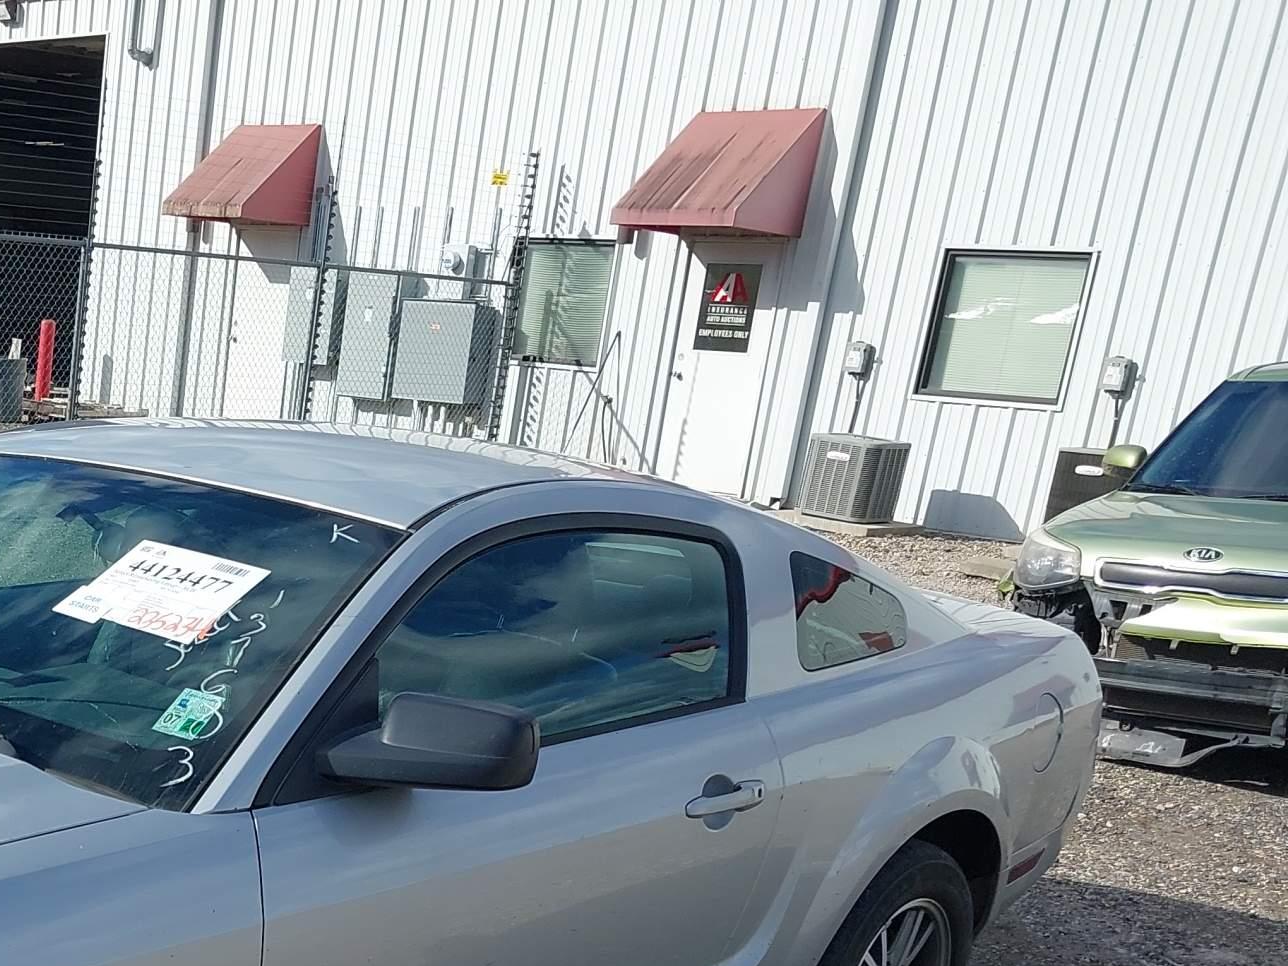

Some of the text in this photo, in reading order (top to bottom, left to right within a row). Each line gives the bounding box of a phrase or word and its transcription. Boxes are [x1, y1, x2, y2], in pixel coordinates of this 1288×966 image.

[707, 307, 748, 315] INSURANCE
[720, 316, 747, 324] AUCTIONS
[698, 328, 749, 339] EMPLOYEES ONLY
[329, 523, 360, 544] K
[127, 558, 235, 594] 44124477
[162, 712, 182, 724] 07
